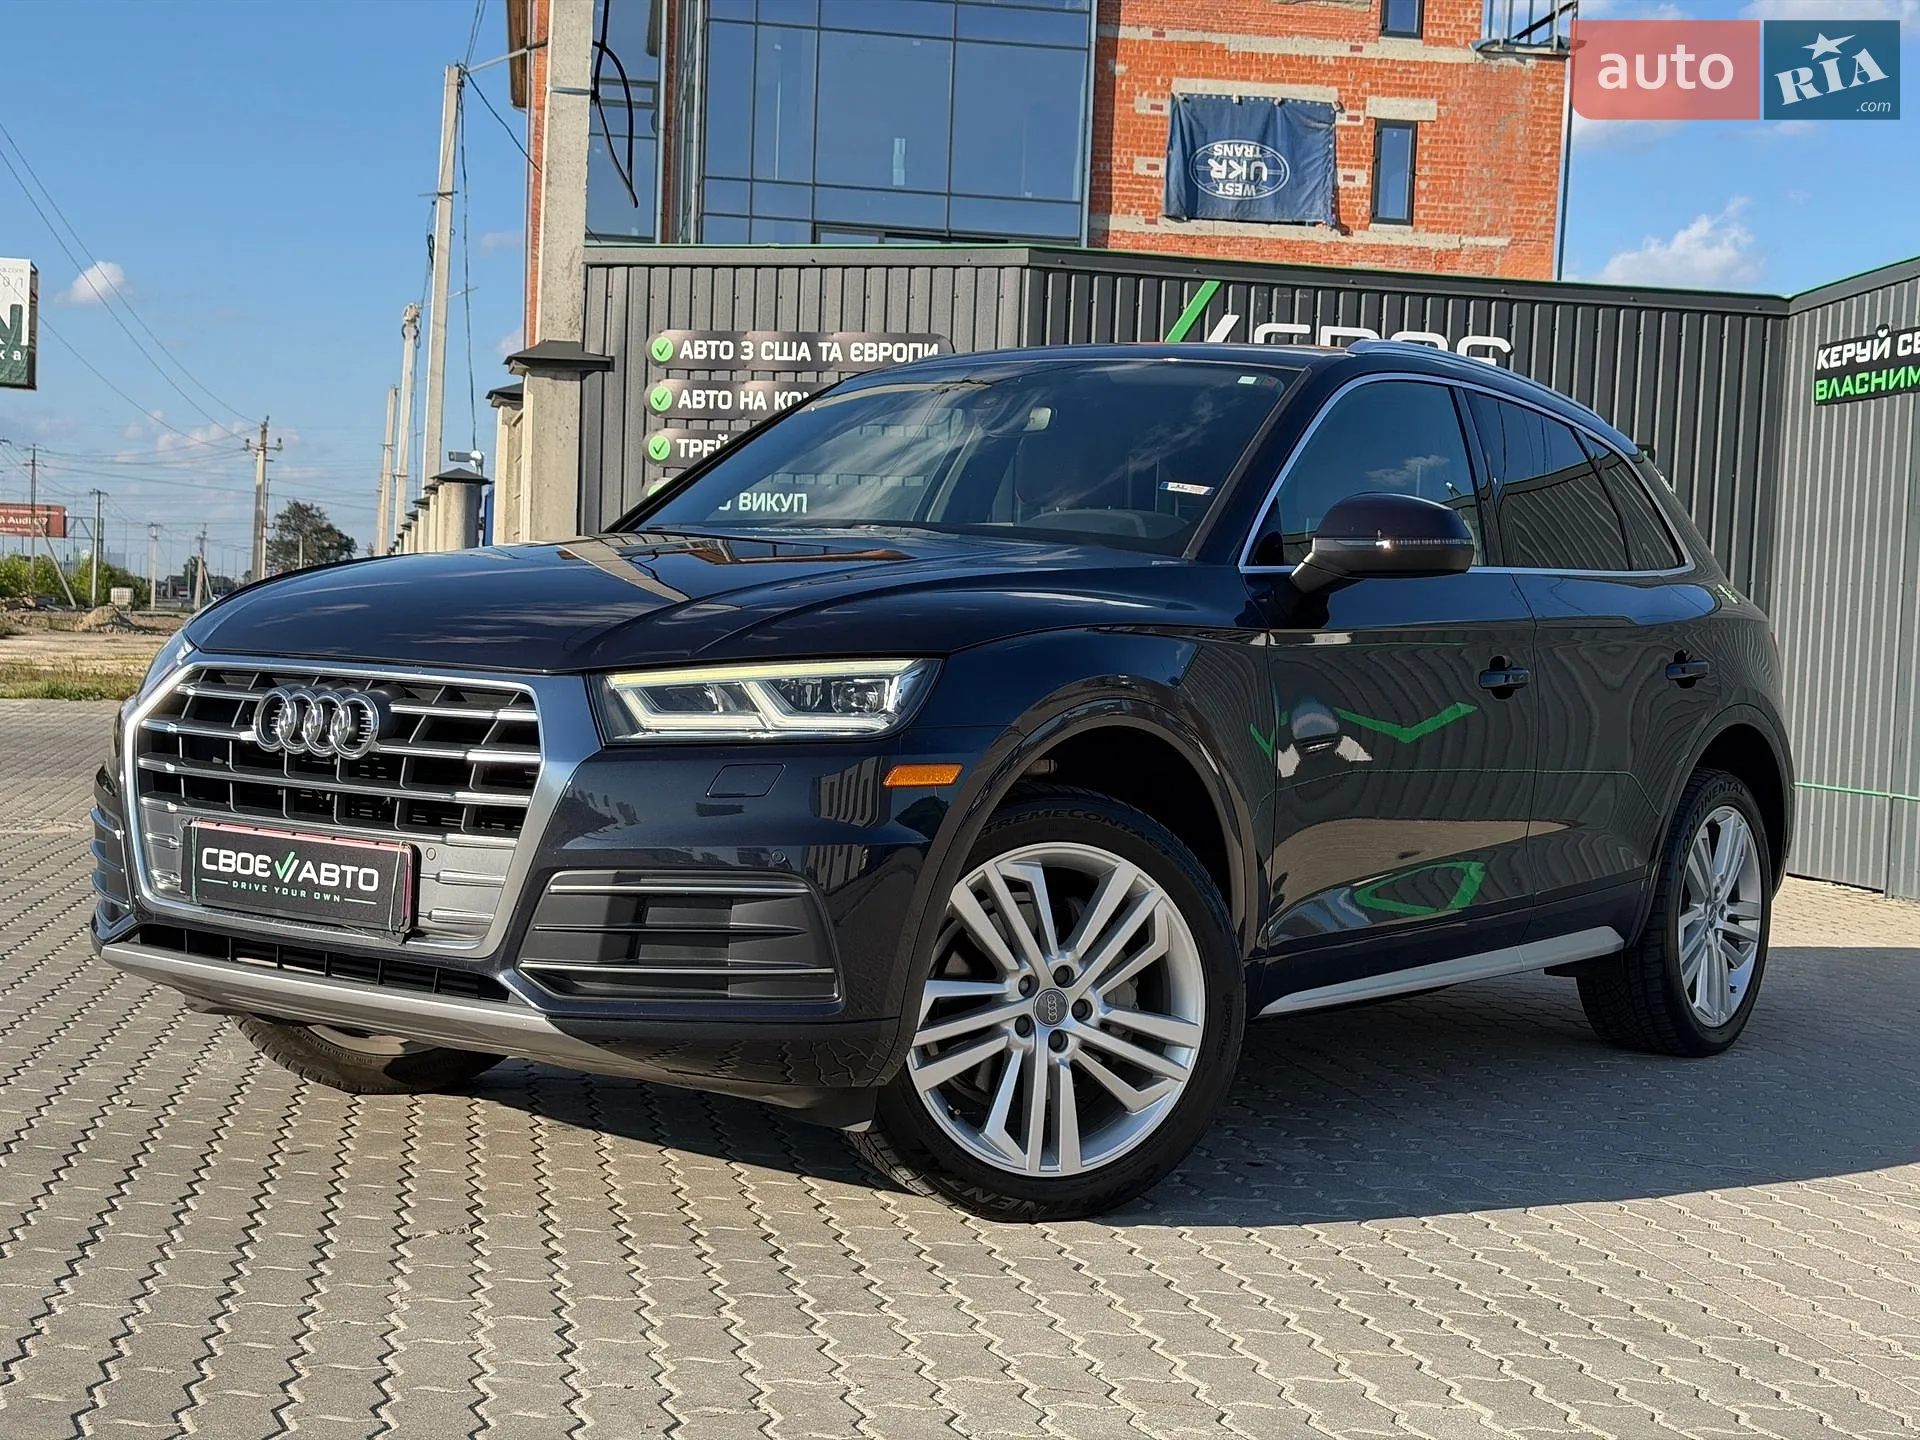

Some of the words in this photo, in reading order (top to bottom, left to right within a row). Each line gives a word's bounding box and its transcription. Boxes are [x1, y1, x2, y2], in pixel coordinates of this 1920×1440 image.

[1213, 143, 1260, 157] TRANS
[1207, 158, 1268, 181] UKR
[1216, 183, 1256, 197] WEST
[680, 340, 734, 360] АВТО
[740, 341, 754, 360] З
[760, 341, 812, 362] США
[818, 341, 844, 363] ТА
[850, 342, 938, 363] ЄВРОПИ
[1816, 329, 1891, 370] КЕРУЙ
[1815, 365, 1920, 401] ВЛАСНИМ
[677, 389, 733, 410] АВТО
[740, 391, 768, 411] НА
[739, 492, 808, 514] ВИКУП
[7, 516, 31, 525] Audi
[297, 860, 379, 892] АВТО
[232, 880, 268, 893] DRIVE
[274, 886, 306, 898] YOUR
[313, 892, 341, 902] OWN
